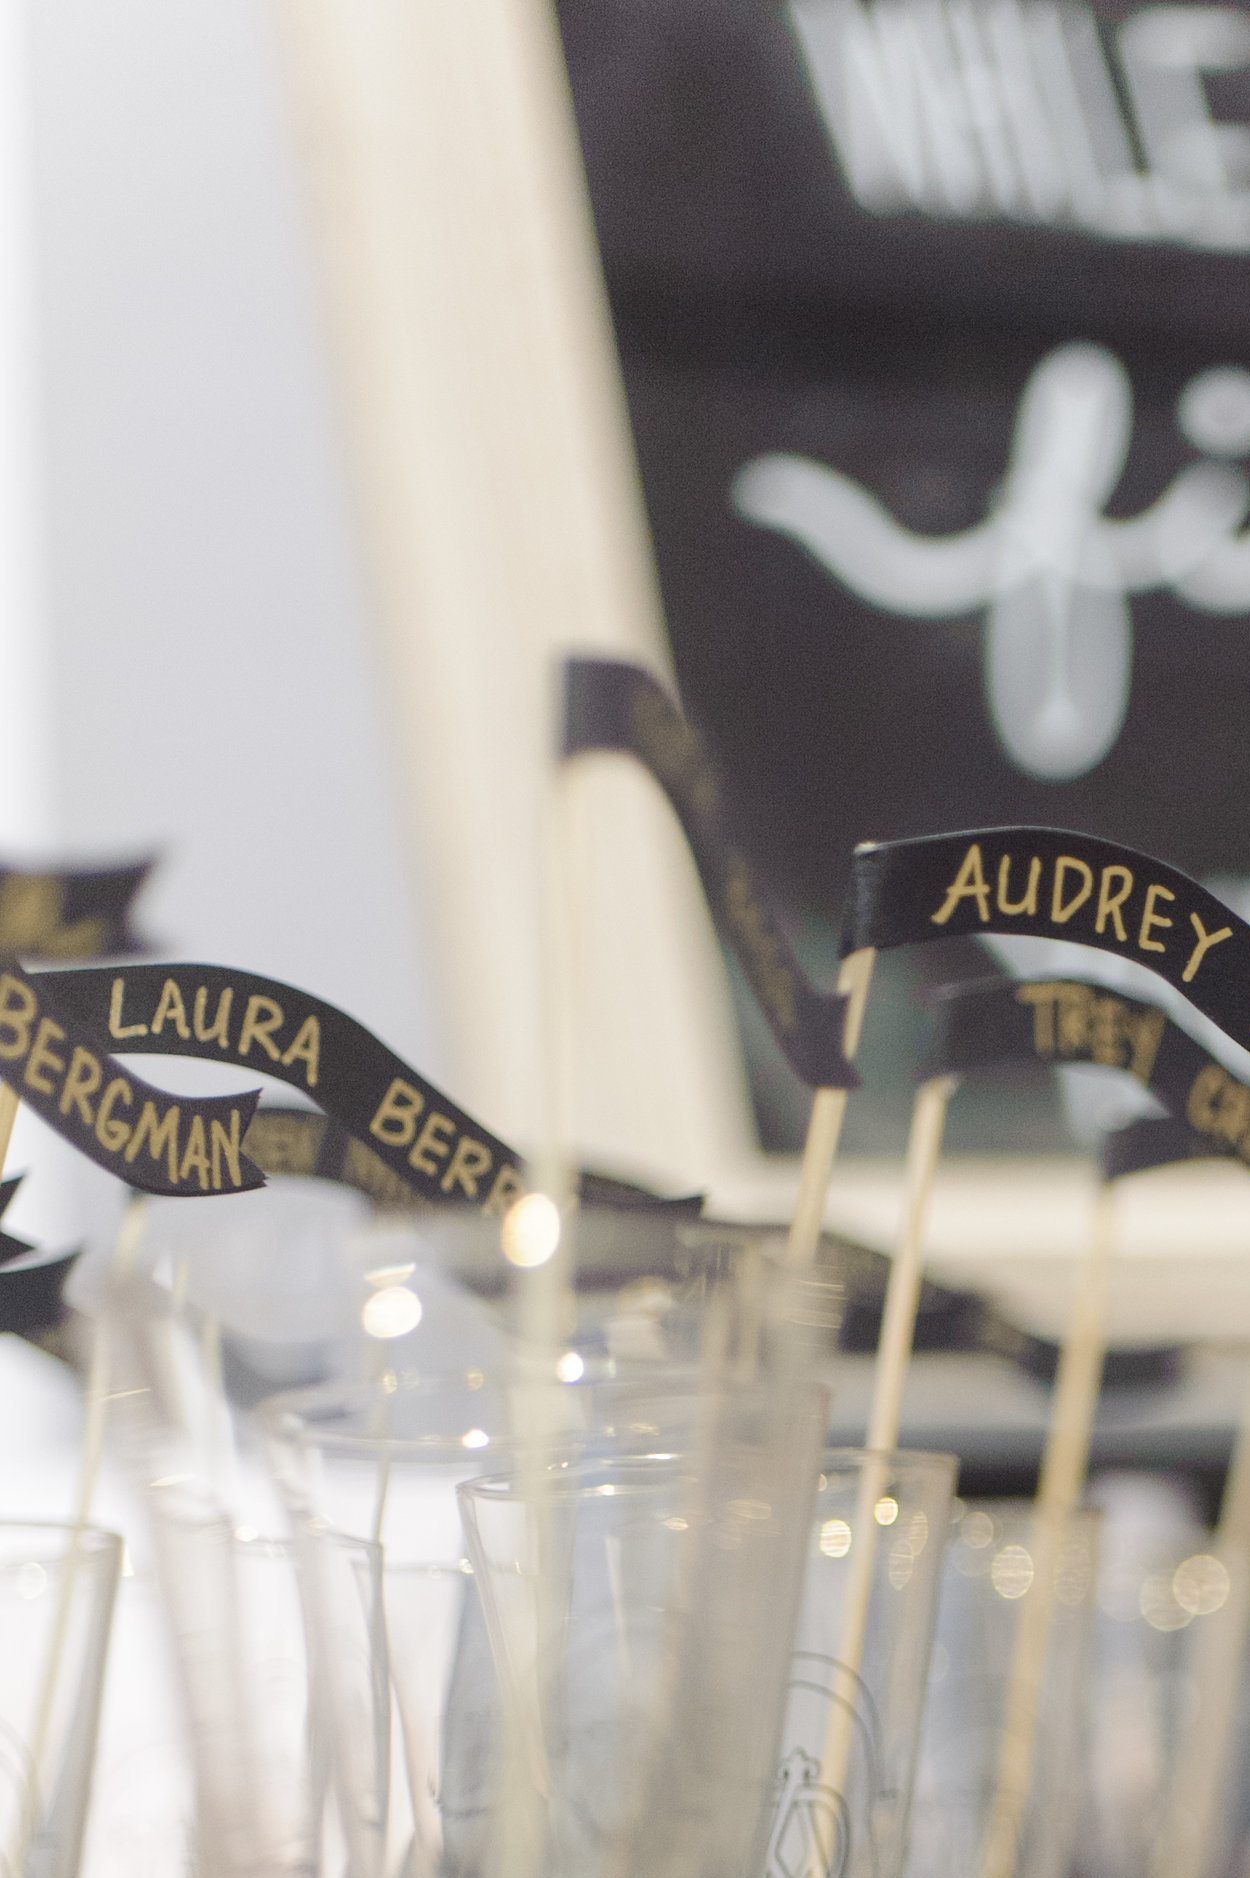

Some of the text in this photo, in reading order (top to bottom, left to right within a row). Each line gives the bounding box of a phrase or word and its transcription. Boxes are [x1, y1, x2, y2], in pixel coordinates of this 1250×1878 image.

[931, 843, 1233, 983] AUDREY
[0, 973, 242, 1190] BERGMAN
[108, 977, 322, 1088] LAURA
[369, 1077, 526, 1217] BERR
